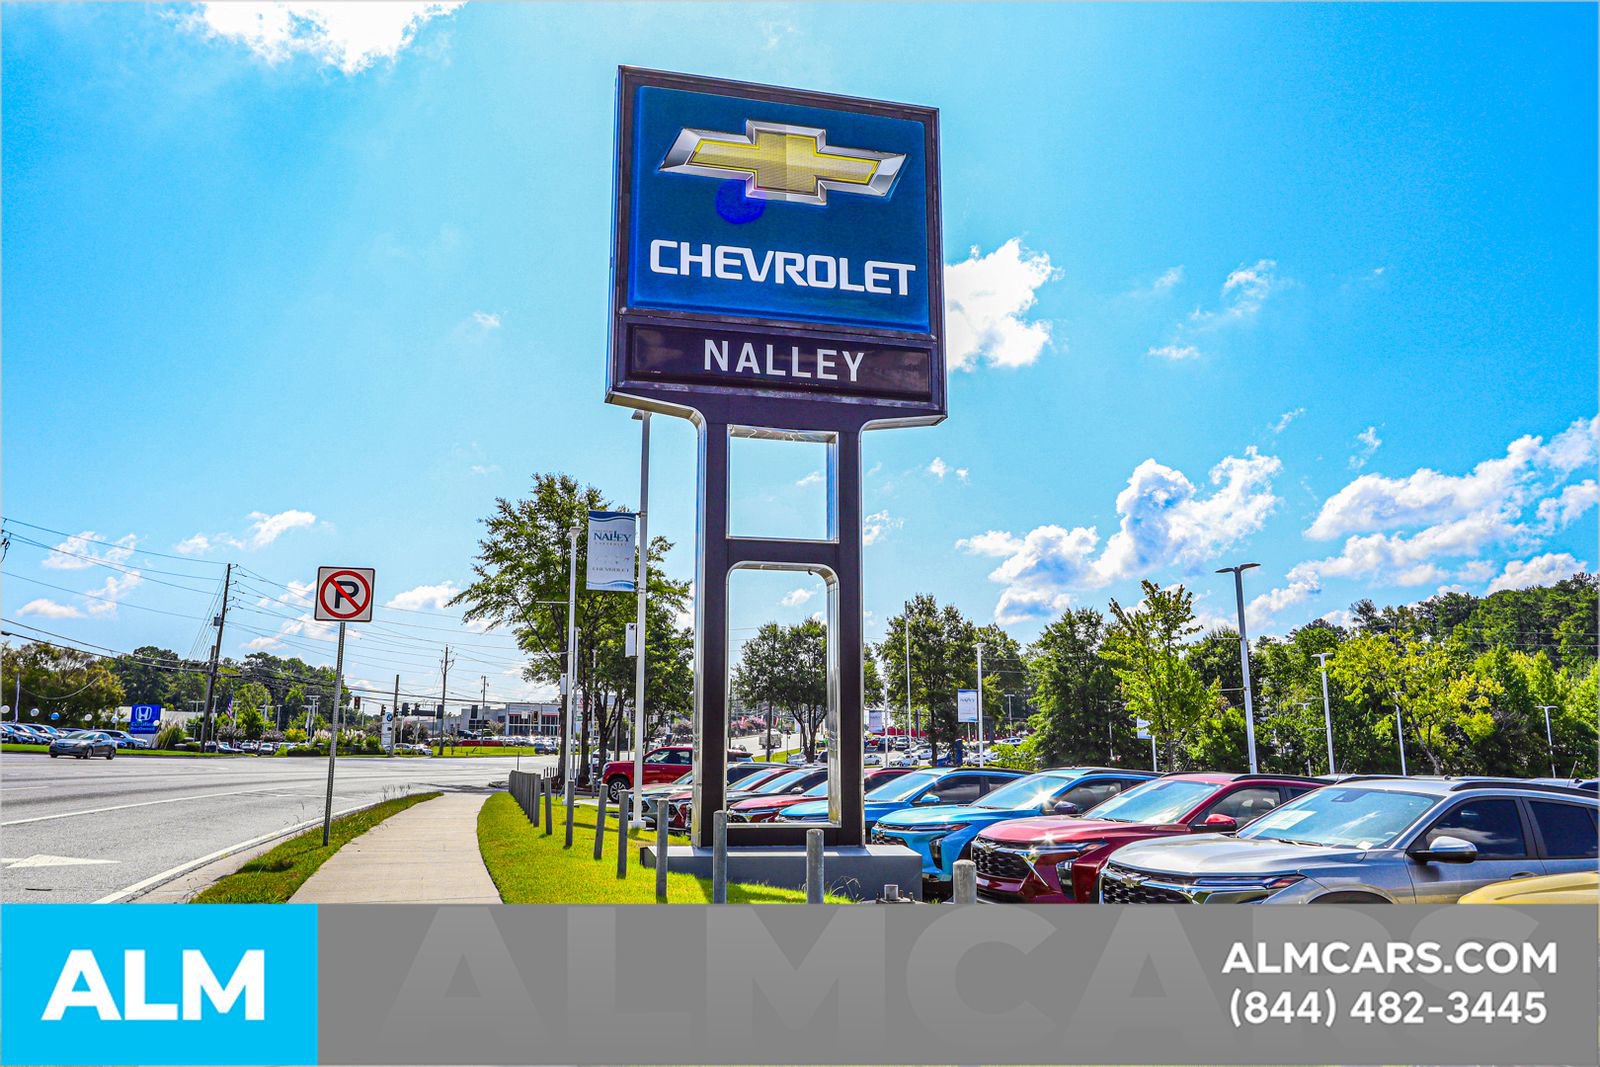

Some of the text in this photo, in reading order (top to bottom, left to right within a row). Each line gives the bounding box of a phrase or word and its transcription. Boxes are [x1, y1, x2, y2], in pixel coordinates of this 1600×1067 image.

[650, 239, 916, 296] CHEVROLET
[704, 339, 865, 382] NALLEY
[593, 530, 632, 542] NALLEY
[334, 580, 360, 609] P
